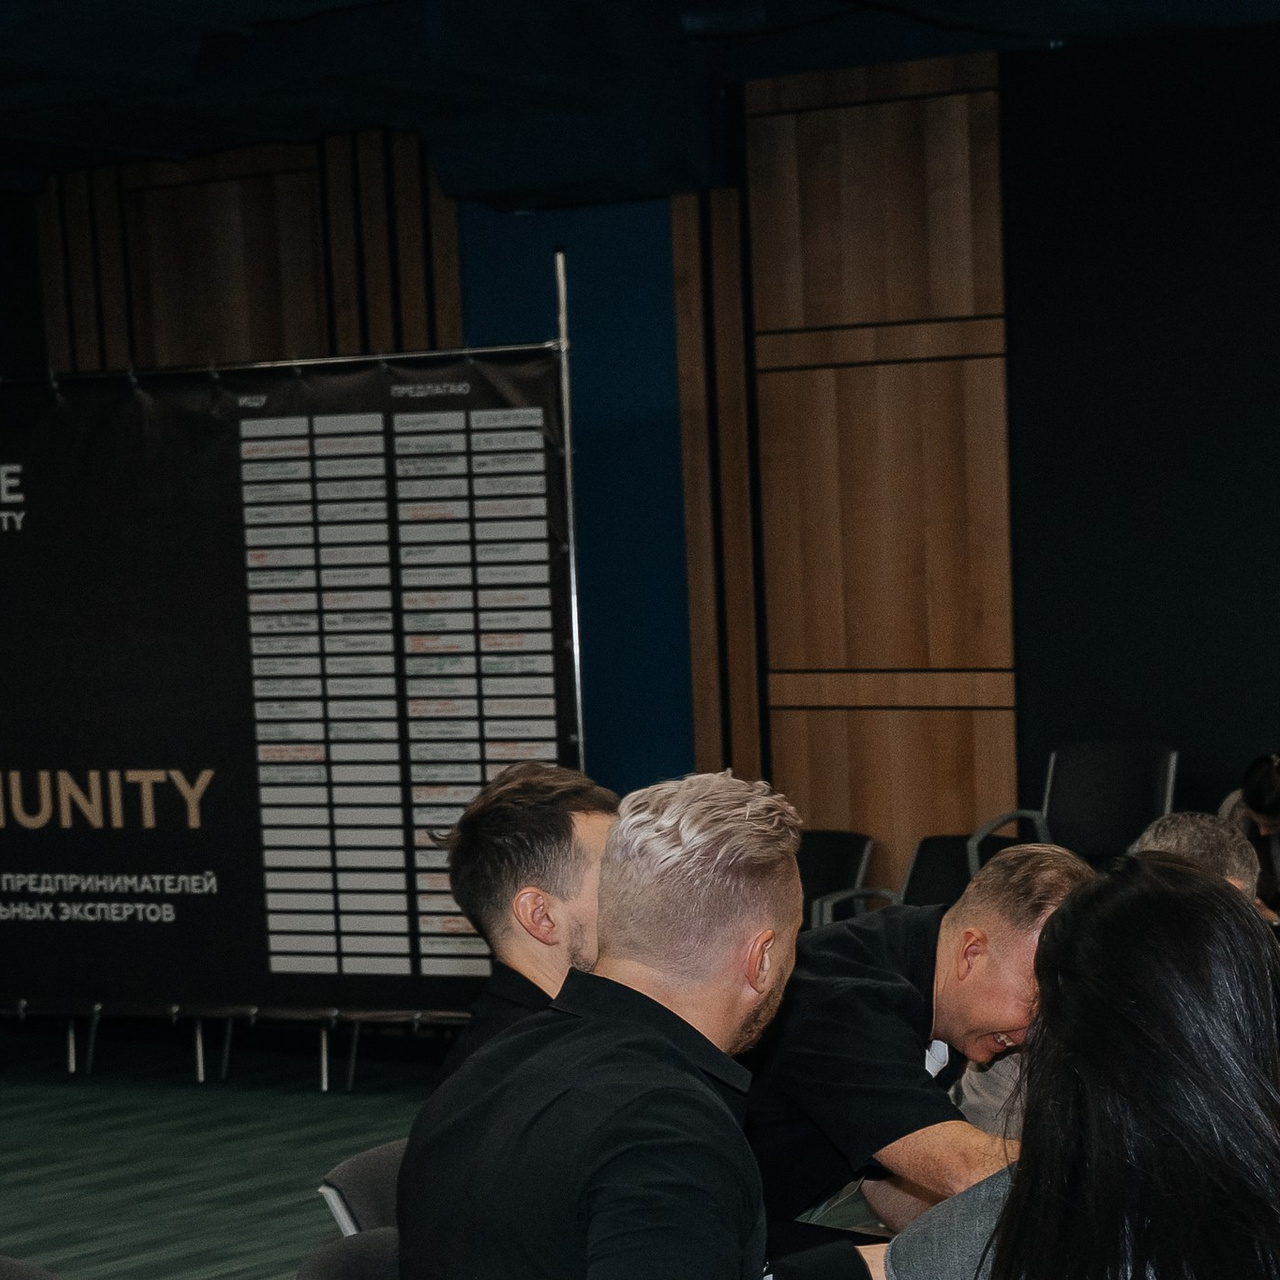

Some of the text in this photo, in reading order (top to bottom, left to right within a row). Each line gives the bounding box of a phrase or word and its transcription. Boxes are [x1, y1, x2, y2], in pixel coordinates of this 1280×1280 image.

[0, 769, 215, 829] UNITY
[1, 870, 218, 894] ПРЕДПРИНИМАТЕЛЕЙ
[58, 902, 176, 922] ЭКСПЕРТОВ
